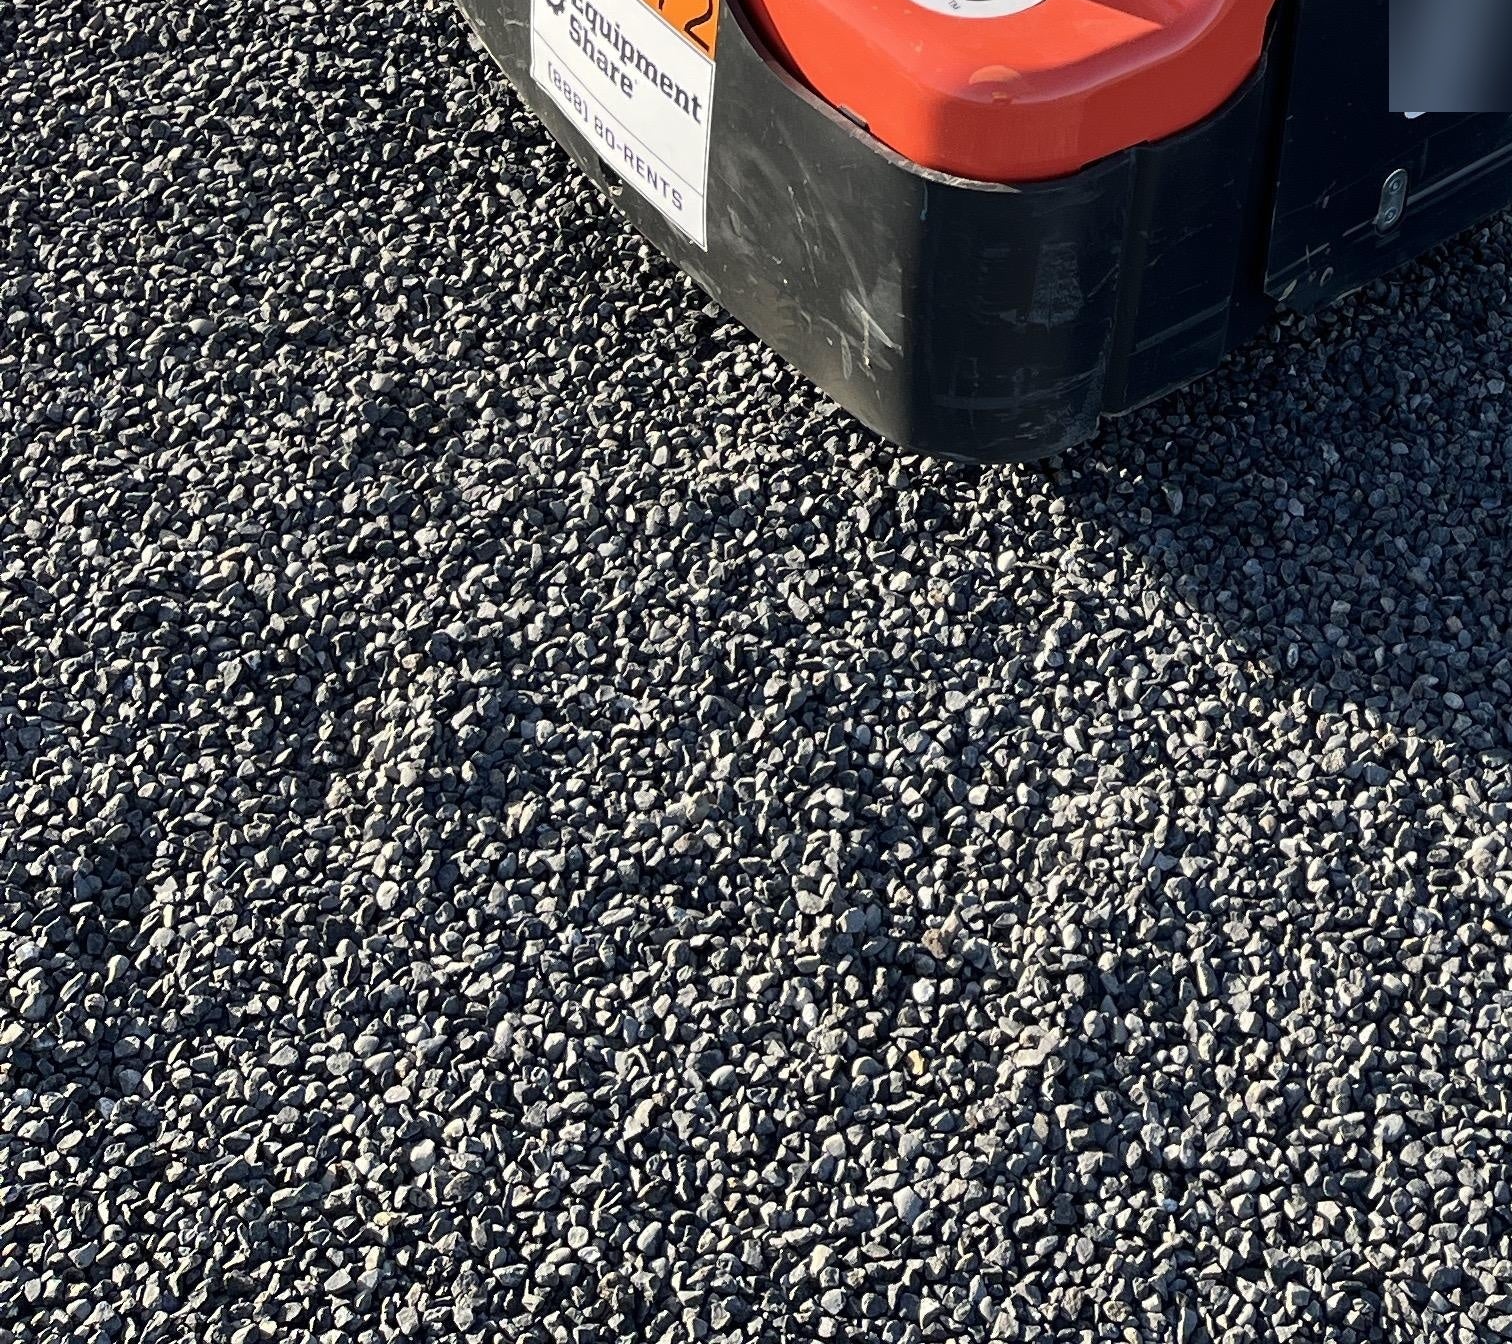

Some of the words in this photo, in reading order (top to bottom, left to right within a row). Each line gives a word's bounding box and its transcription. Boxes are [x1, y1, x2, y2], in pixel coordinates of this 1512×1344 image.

[568, 14, 634, 99] Share
[548, 60, 589, 123] (888)
[594, 115, 684, 212] 80-RENTS
